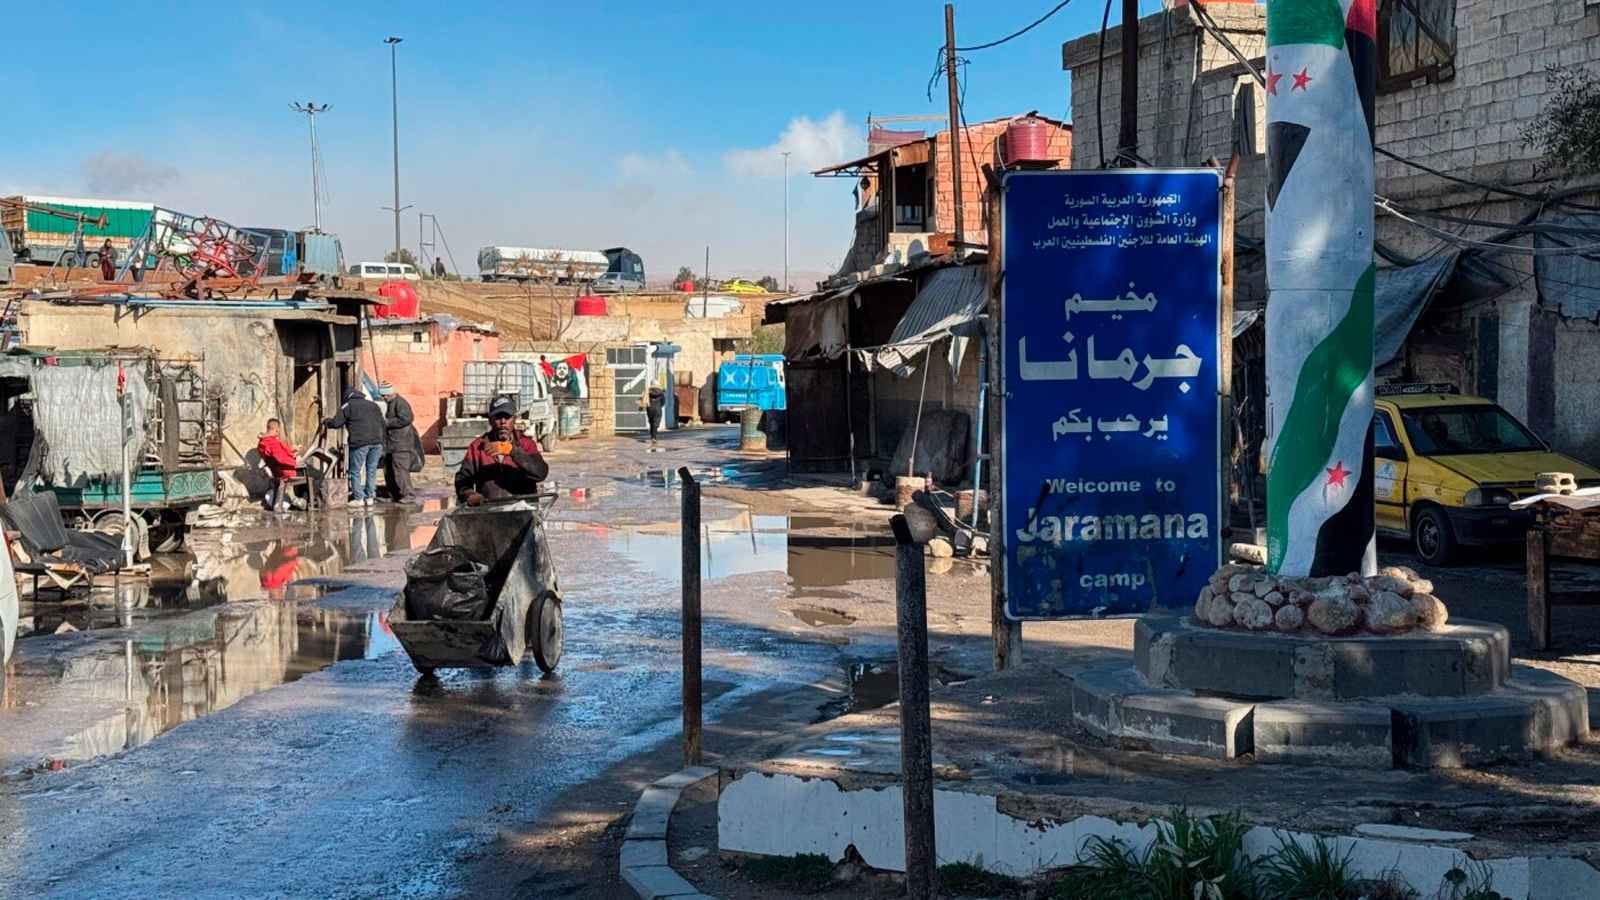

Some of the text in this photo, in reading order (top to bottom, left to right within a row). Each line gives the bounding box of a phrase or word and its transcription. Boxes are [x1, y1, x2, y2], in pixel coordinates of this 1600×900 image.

[1064, 192, 1181, 208] الجمهورية العربية السورية
[1047, 215, 1080, 229] والعمل
[1136, 210, 1170, 228] الشؤون
[1172, 211, 1198, 228] وزارة
[1033, 232, 1211, 249] الهيئة العامة للاجئين الفلسطينيين العرب
[1065, 281, 1158, 321] مخيم
[1018, 331, 1202, 394] جرمانا
[1052, 408, 1169, 442] يرحب بكم
[1047, 478, 1176, 493] Welcome to
[1016, 508, 1209, 543] Jaramana
[1079, 573, 1145, 590] camp
